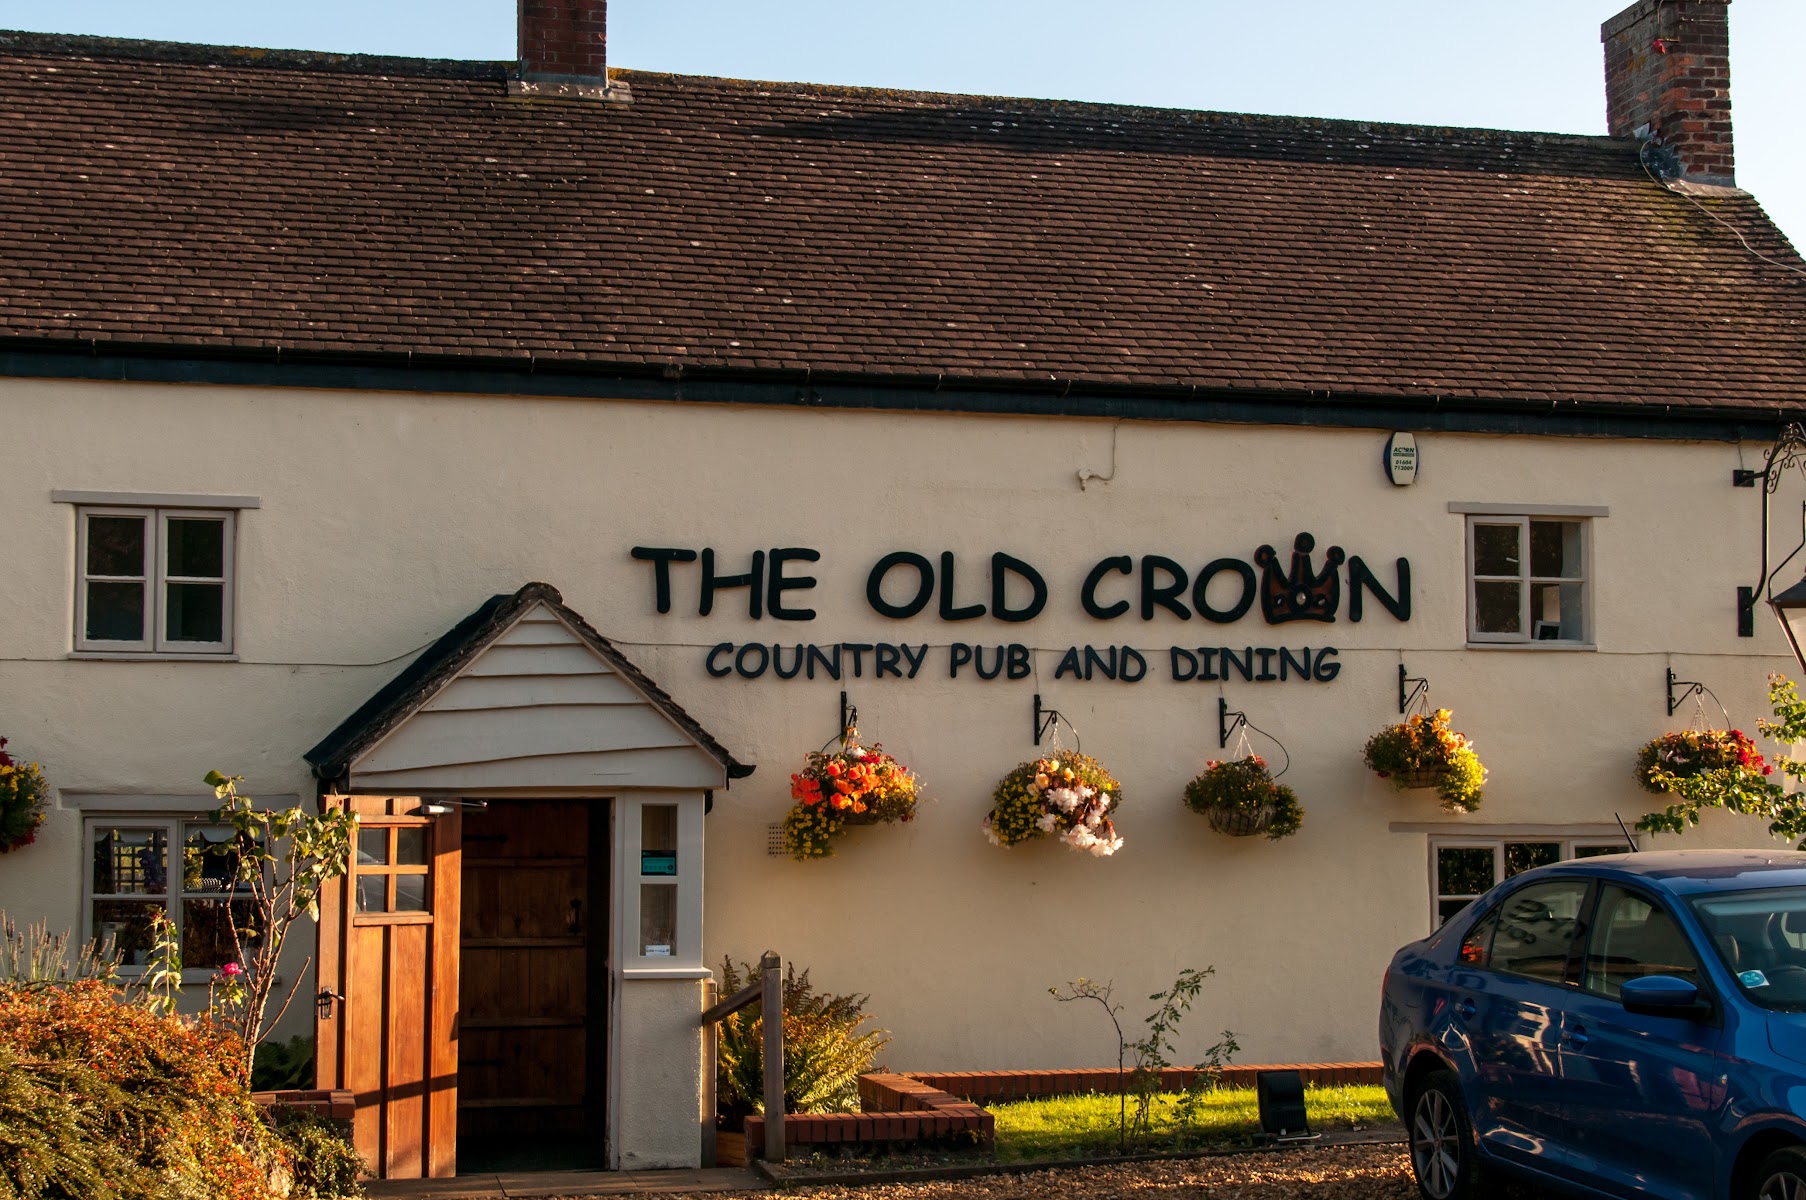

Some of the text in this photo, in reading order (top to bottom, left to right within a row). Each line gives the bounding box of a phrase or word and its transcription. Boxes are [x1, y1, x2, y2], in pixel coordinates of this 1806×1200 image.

[631, 532, 1411, 625] THE OLD CROWN
[706, 643, 1341, 683] COUNTRY PUB AND DINING
